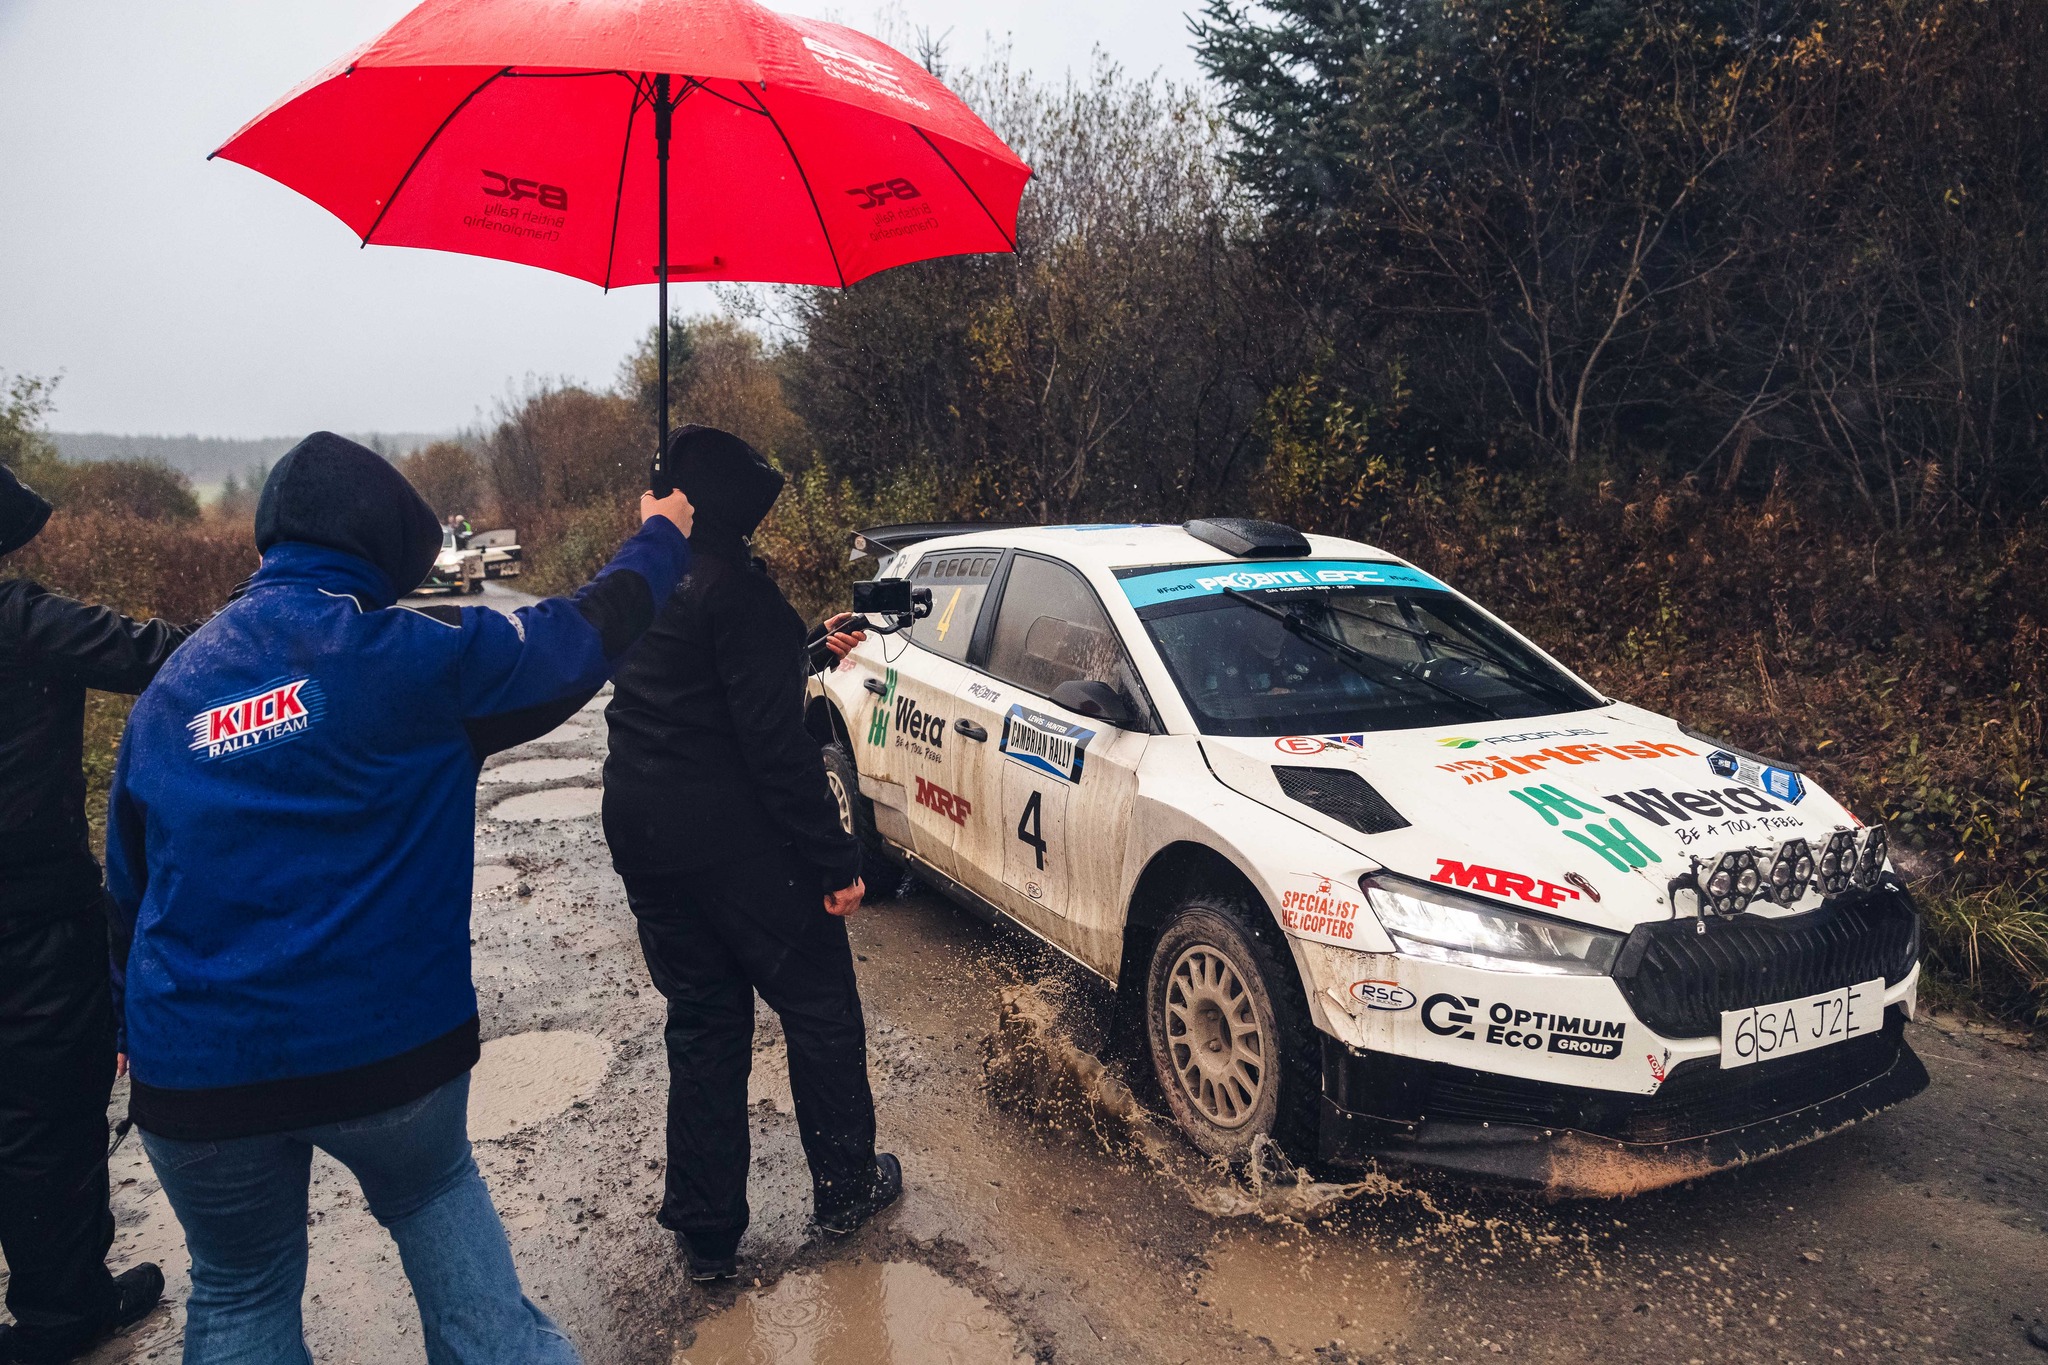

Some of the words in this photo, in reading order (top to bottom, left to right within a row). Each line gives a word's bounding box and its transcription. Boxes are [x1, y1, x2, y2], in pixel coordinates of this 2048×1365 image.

[812, 53, 866, 78] British
[865, 71, 905, 93] Rally
[823, 66, 931, 110] Championship
[1156, 583, 1196, 594] #ForDai
[1195, 570, 1311, 591] PROBITE
[936, 588, 962, 642] 4
[968, 682, 1001, 704] PROBITE
[208, 683, 305, 742] KICK
[895, 695, 946, 748] Wera
[1028, 714, 1045, 726] LEWIS
[1045, 720, 1068, 734] HUNTER
[209, 731, 263, 758] RALLY
[265, 715, 308, 740] TEAM
[1010, 721, 1047, 758] CAMBRIAN
[1049, 736, 1072, 769] RALLY
[1286, 739, 1314, 751] E
[1484, 728, 1609, 746] ADDFUEL
[924, 747, 942, 764] REBEL
[1437, 740, 1700, 784] DirtFish
[915, 775, 972, 827] MRF
[1602, 786, 1785, 827] Wera
[1018, 790, 1047, 871] 4
[1675, 828, 1701, 845] BE
[1707, 823, 1719, 836] A
[1757, 815, 1804, 832] REBEL
[1429, 858, 1580, 909] MRF
[1282, 890, 1359, 920] SPECIALIST
[1281, 909, 1354, 940] HELICOPTERS
[1361, 984, 1403, 1003] RSC
[1488, 1002, 1626, 1039] OPTIMUM
[1486, 1024, 1543, 1050] ECO
[1556, 1038, 1614, 1055] GROUP
[1649, 1055, 1664, 1077] TOW
